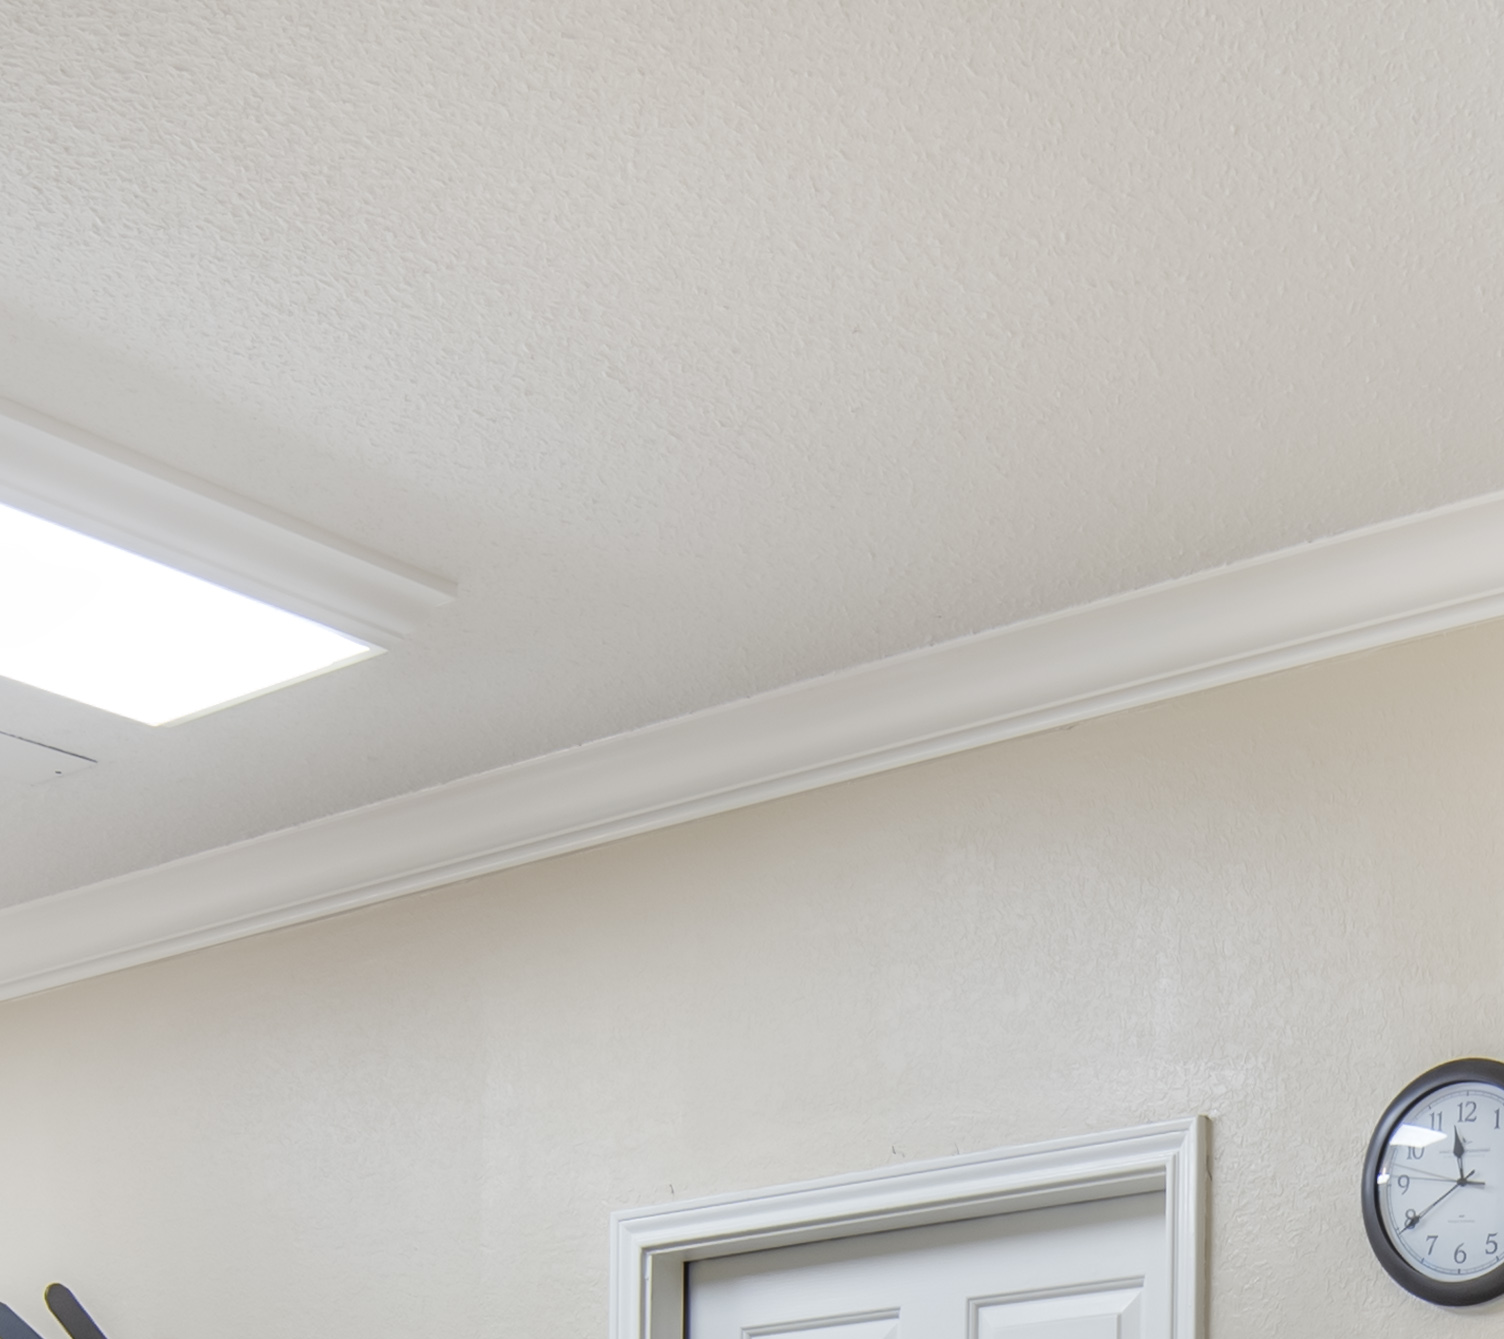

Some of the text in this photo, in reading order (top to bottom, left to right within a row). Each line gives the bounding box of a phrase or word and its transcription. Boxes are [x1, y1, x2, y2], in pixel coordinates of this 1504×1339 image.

[1430, 1111, 1444, 1132] 11
[1457, 1101, 1478, 1123] 12
[1494, 1109, 1502, 1130] 1
[1397, 1175, 1410, 1195] 9
[1426, 1235, 1438, 1255] 7
[1453, 1243, 1467, 1264] 6
[1485, 1233, 1498, 1255] 5
